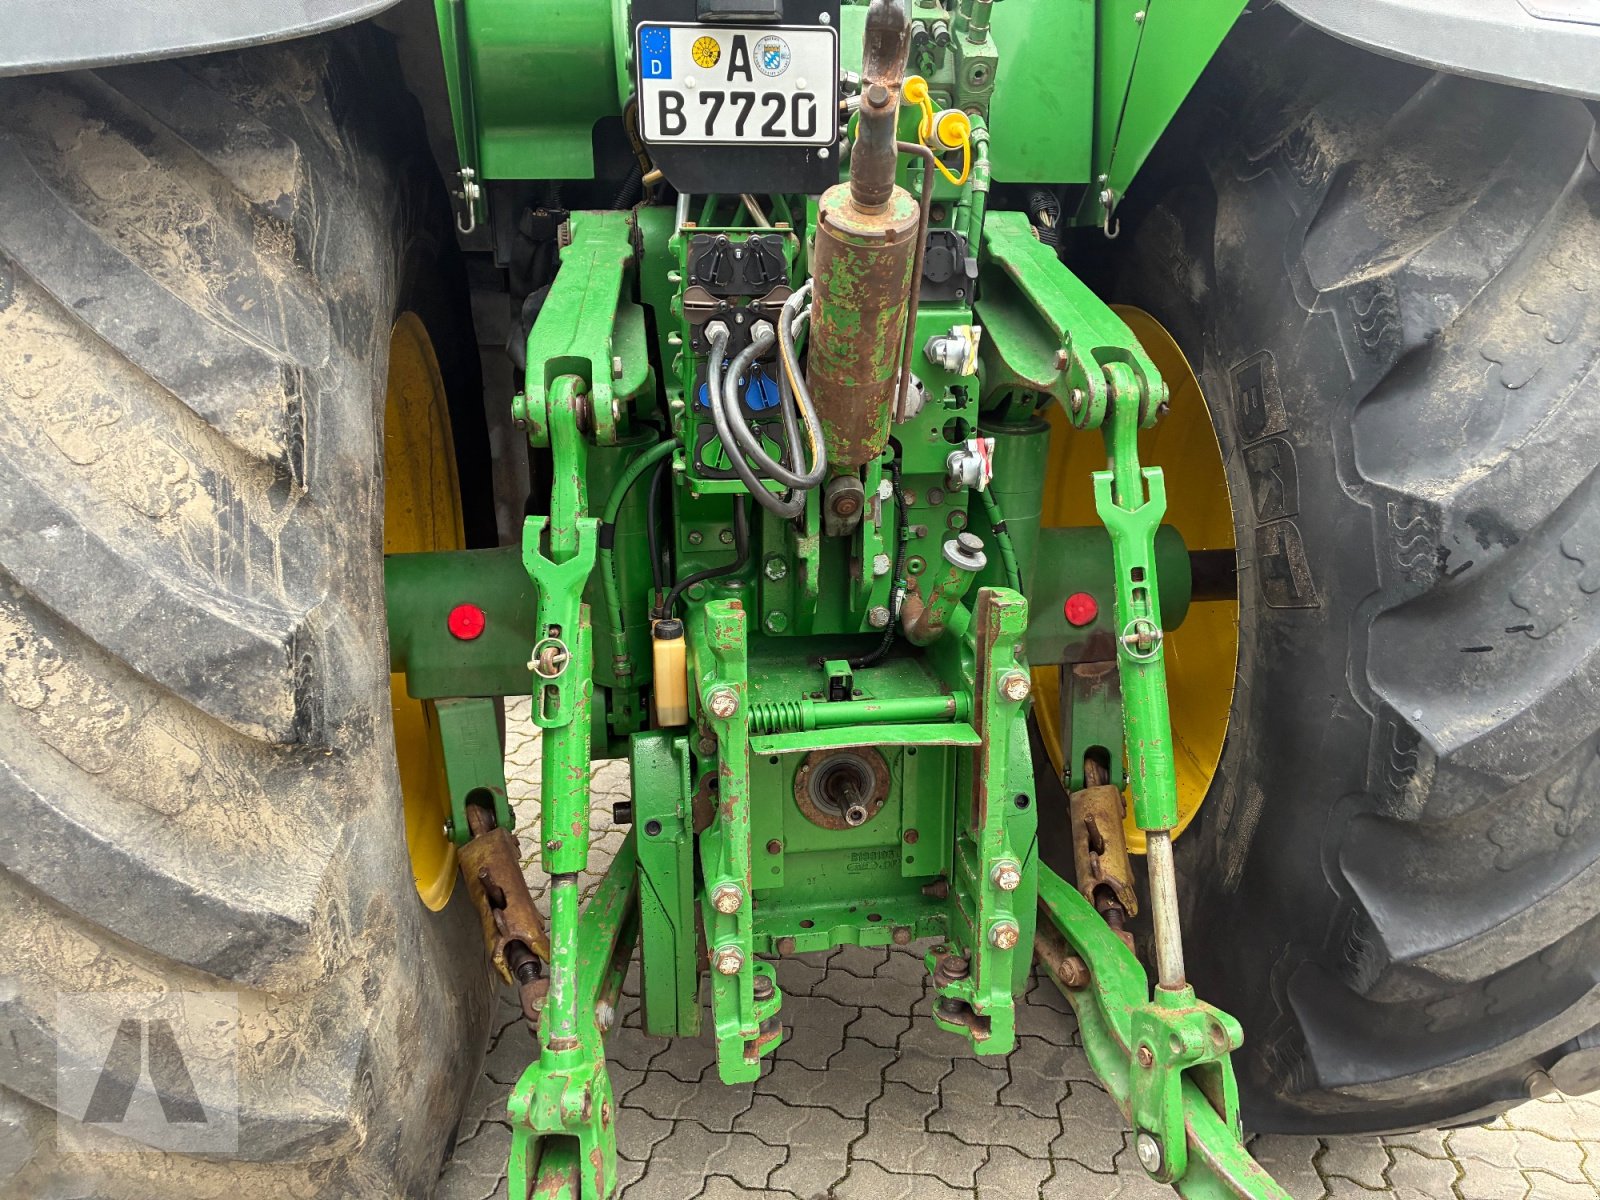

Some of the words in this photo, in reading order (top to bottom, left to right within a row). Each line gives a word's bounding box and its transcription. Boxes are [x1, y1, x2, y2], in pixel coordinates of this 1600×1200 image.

[651, 60, 662, 75] D
[727, 35, 753, 82] A
[659, 91, 687, 136] B
[699, 91, 817, 138] 7720
